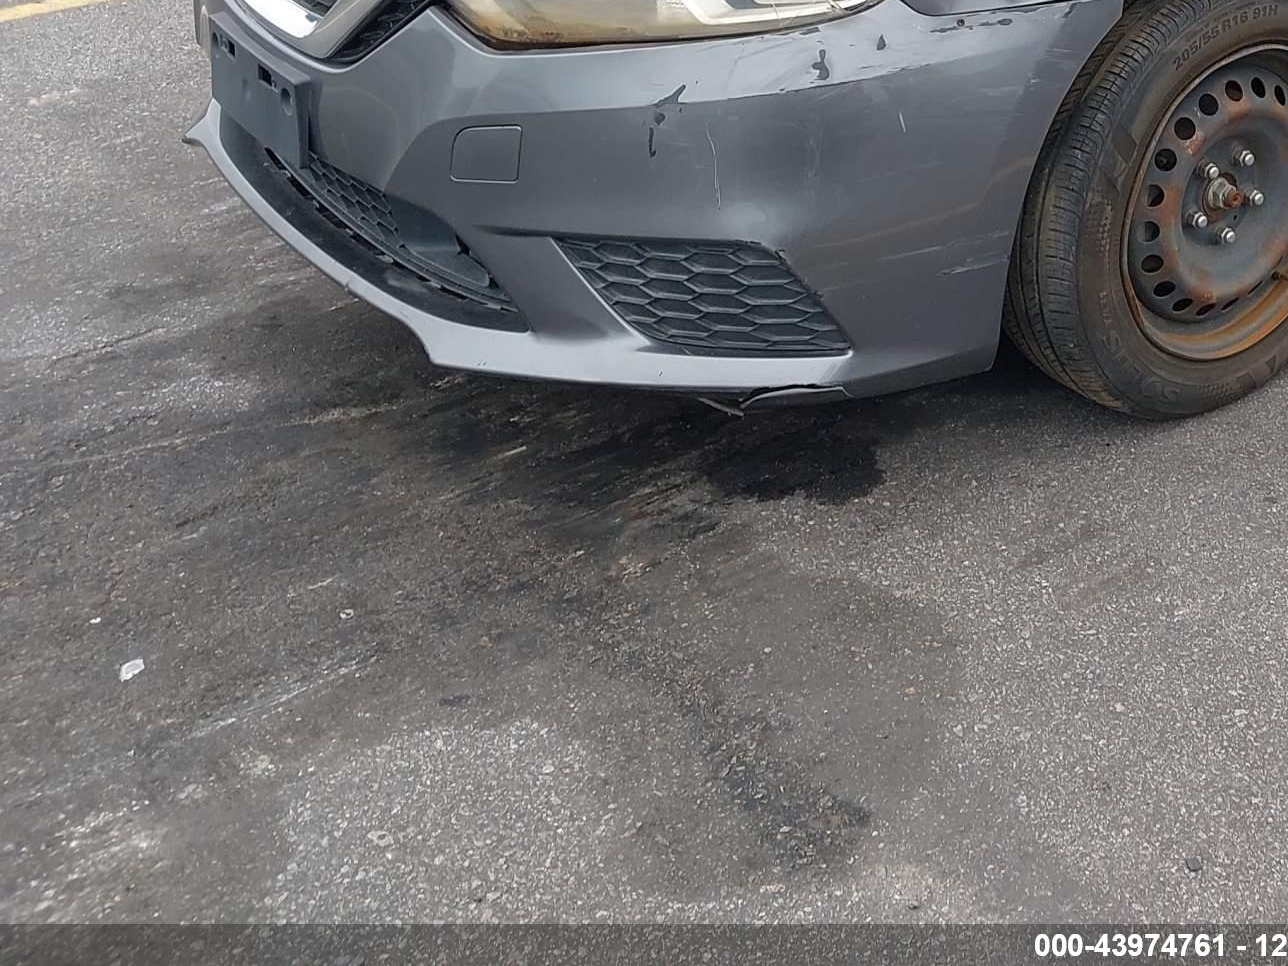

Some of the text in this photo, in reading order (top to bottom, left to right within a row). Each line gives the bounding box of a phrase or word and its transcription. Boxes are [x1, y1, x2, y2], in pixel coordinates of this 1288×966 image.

[1173, 4, 1279, 71] 205/55 R16 91H
